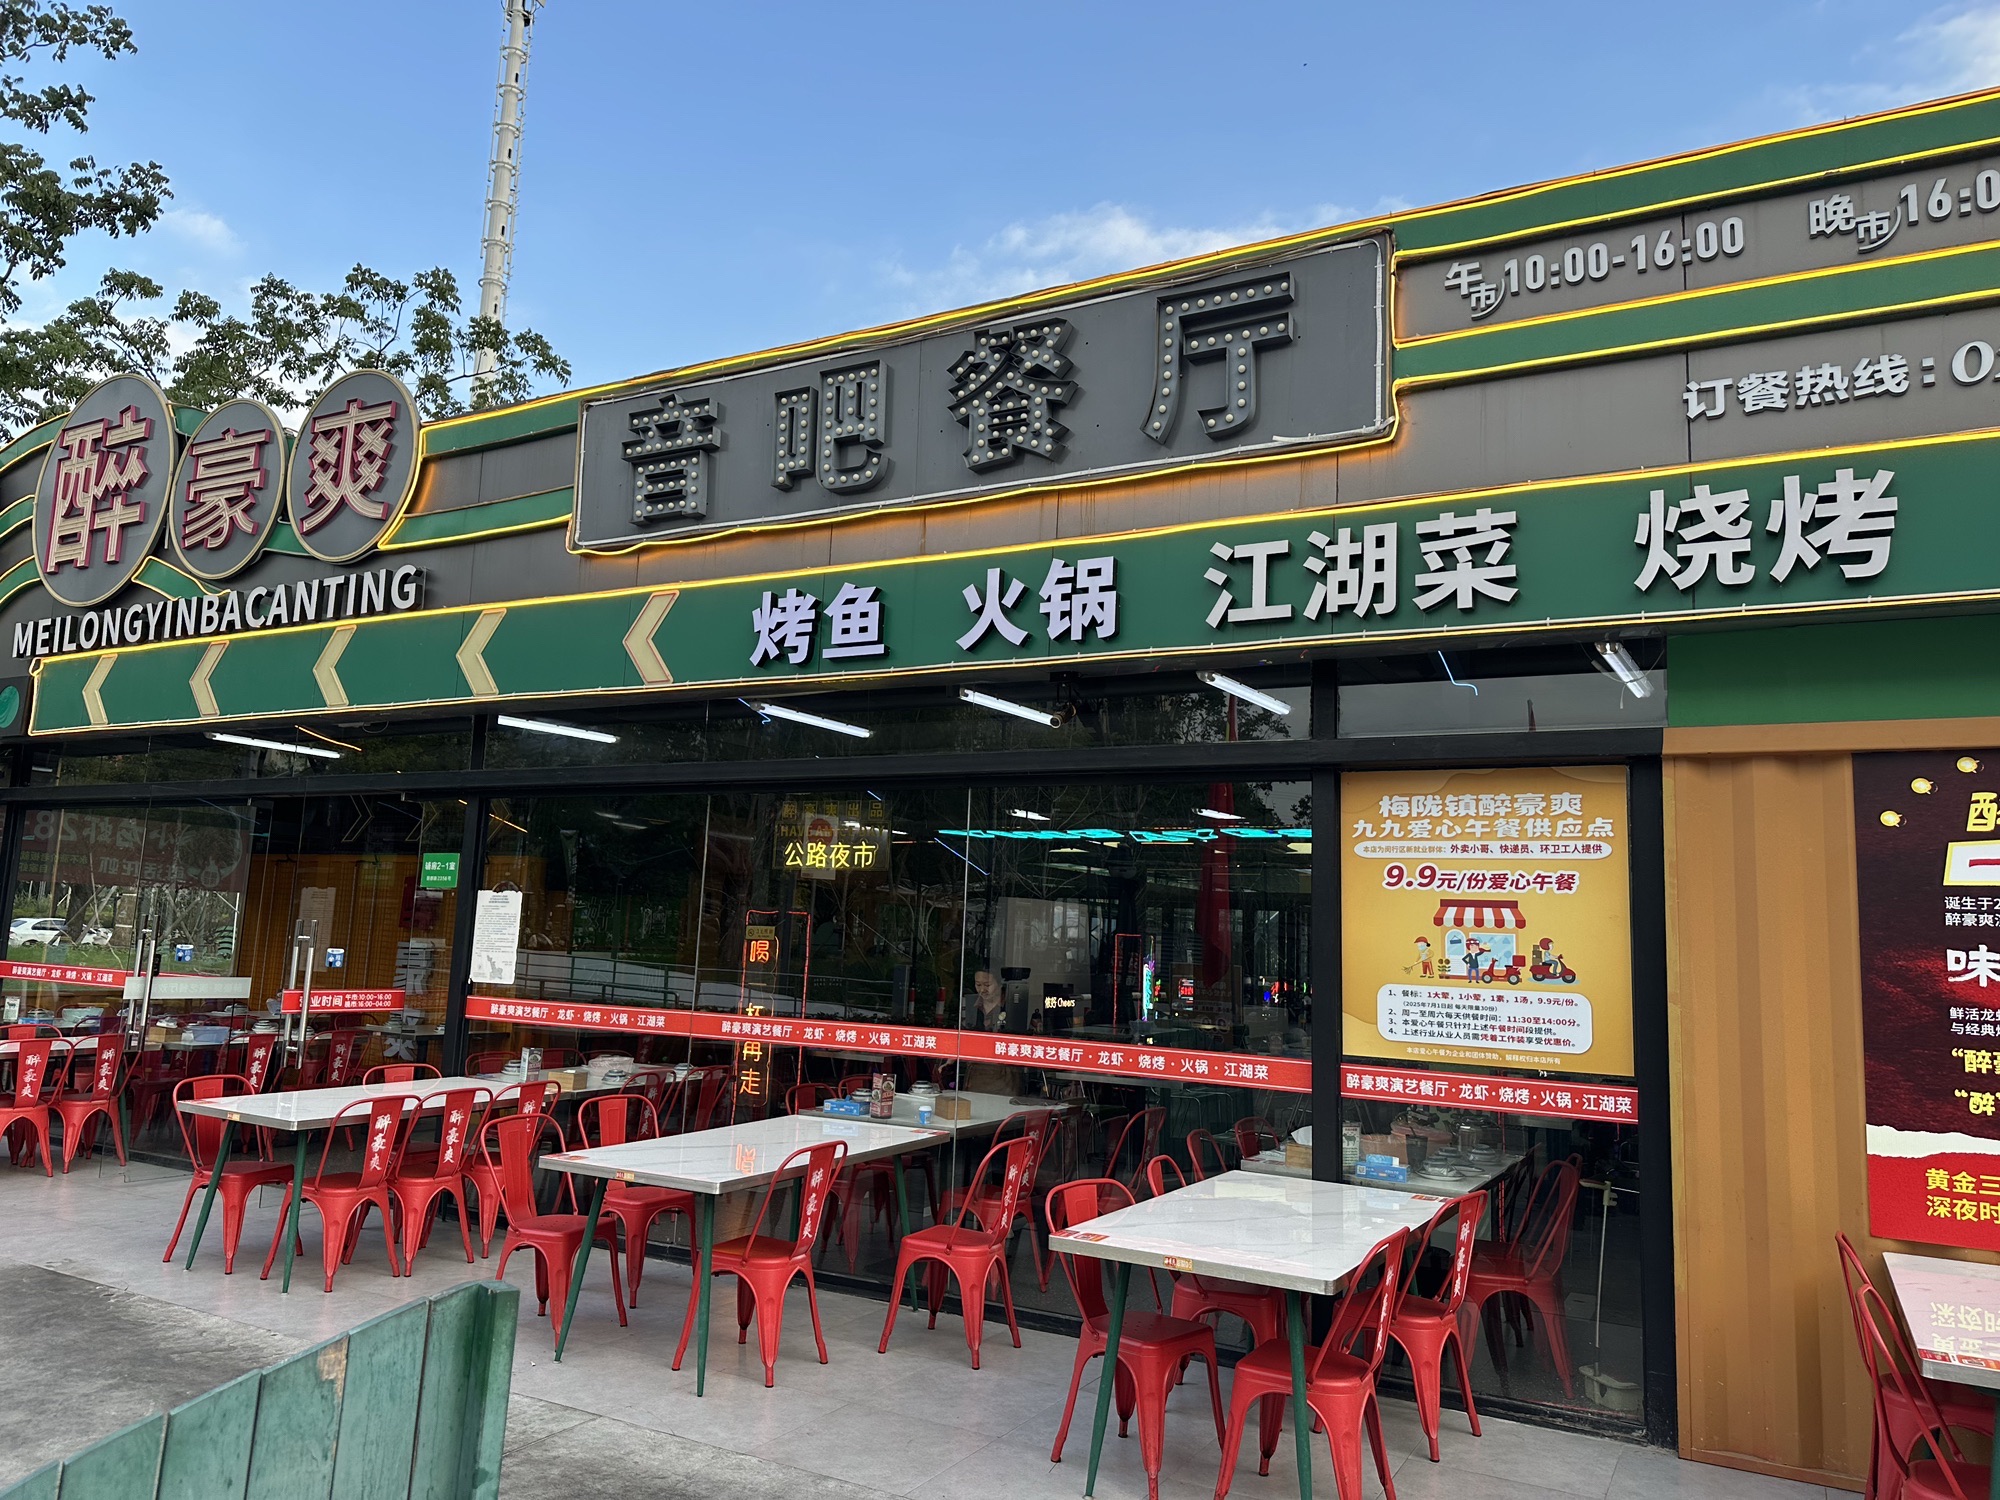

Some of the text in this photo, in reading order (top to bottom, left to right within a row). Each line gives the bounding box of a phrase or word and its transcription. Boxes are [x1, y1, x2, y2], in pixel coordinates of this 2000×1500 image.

[621, 271, 1296, 525] 音吧餐厅
[45, 398, 397, 574] 醉豪爽
[749, 468, 1898, 667] 烤鱼 火锅 江湖菜 烧烤
[12, 564, 421, 658] MEILONGYINBACANTING
[1379, 792, 1583, 818] 梅陇镇醉豪爽
[1352, 817, 1614, 839] 九九爱心午餐供应点
[784, 840, 876, 868] 公路夜市
[1386, 864, 1577, 891] 9.9元/份爱心午餐
[1946, 944, 2000, 988] 味
[299, 995, 343, 1007] 业时间
[20, 1053, 42, 1098] 醉豪爽
[1951, 1048, 2000, 1074] “醉
[369, 1114, 392, 1171] 醉豪爽
[442, 1109, 465, 1164] 醉豪爽
[801, 1167, 824, 1239] 醉豪爽
